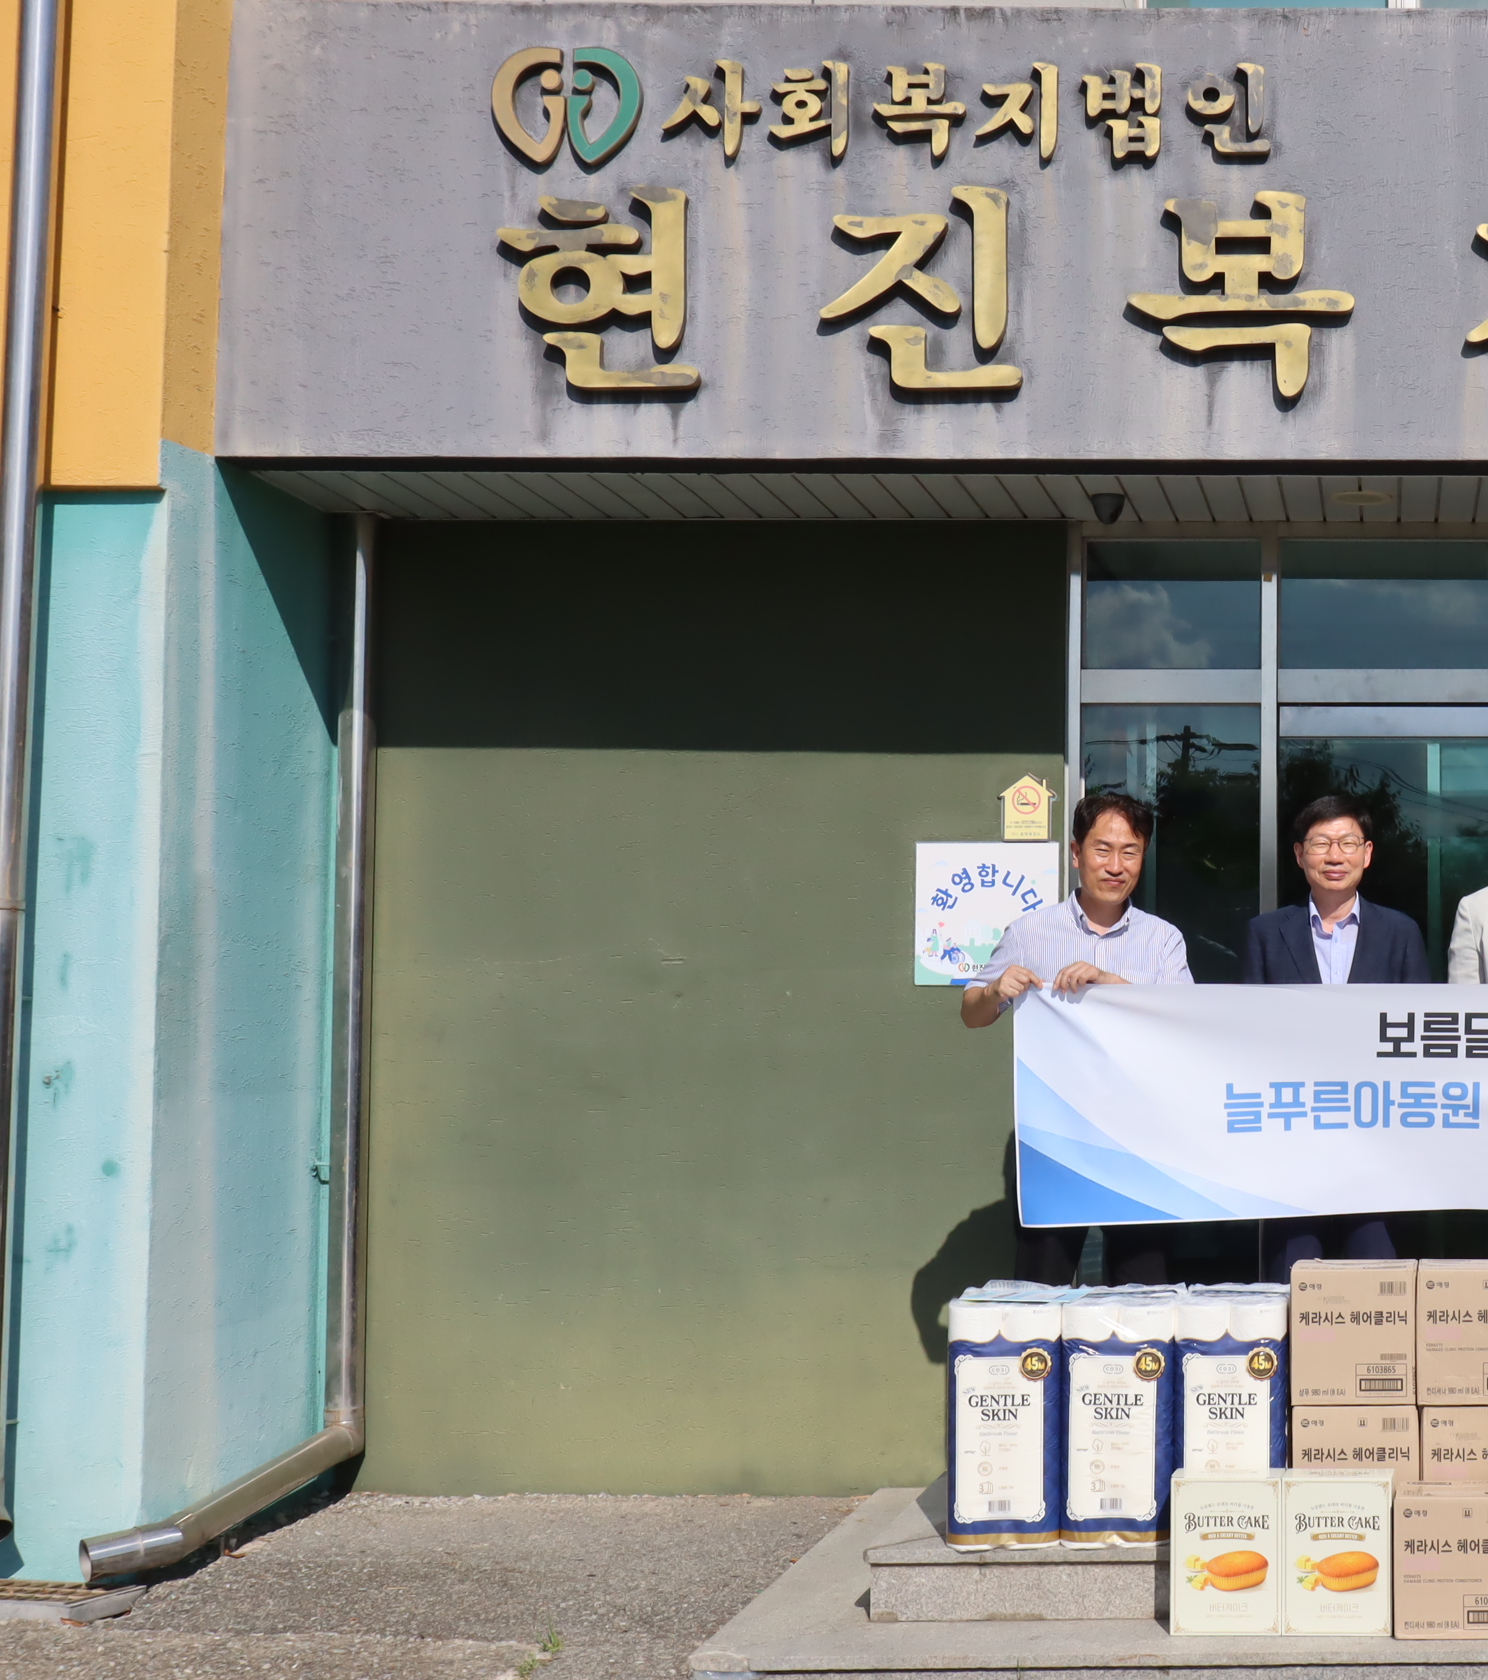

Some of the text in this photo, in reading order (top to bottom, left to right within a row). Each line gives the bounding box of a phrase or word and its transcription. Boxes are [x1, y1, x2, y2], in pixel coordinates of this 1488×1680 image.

[661, 59, 1273, 162] 사회복지법인
[931, 863, 1044, 912] 환영합니다
[1223, 1080, 1480, 1133] 늘푸른아동원
[1299, 1310, 1408, 1326] 케라시스 헤어클리닉
[1426, 1309, 1473, 1324] 케라시스
[1366, 1366, 1396, 1374] 6103865
[962, 1386, 977, 1395] NEW
[1076, 1384, 1091, 1393] NEW
[1190, 1384, 1204, 1393] NEW
[1322, 1388, 1329, 1396] ml
[1336, 1388, 1346, 1397] EA)
[1447, 1387, 1456, 1395] 980
[968, 1394, 1031, 1408] GENTLE
[1081, 1392, 1144, 1406] GENTLE
[1196, 1393, 1257, 1406] GENTLE
[980, 1409, 1018, 1421] SKIN
[1093, 1407, 1131, 1420] SKIN
[1208, 1407, 1245, 1420] SKIN
[1301, 1446, 1410, 1462] 케라시스 헤어클리닉
[1431, 1448, 1478, 1462] 케라시스
[1414, 1509, 1428, 1517] 애경
[1184, 1512, 1270, 1533] BUTTER CAKE
[1294, 1513, 1380, 1534] BUTTER CAKE
[1404, 1539, 1452, 1554] 케라시스
[1209, 1602, 1248, 1612] 버터케이크
[1320, 1603, 1358, 1613] 버터케이크
[1426, 1621, 1436, 1629] 980
[1437, 1620, 1443, 1628] ml
[1451, 1620, 1460, 1629] EA)
